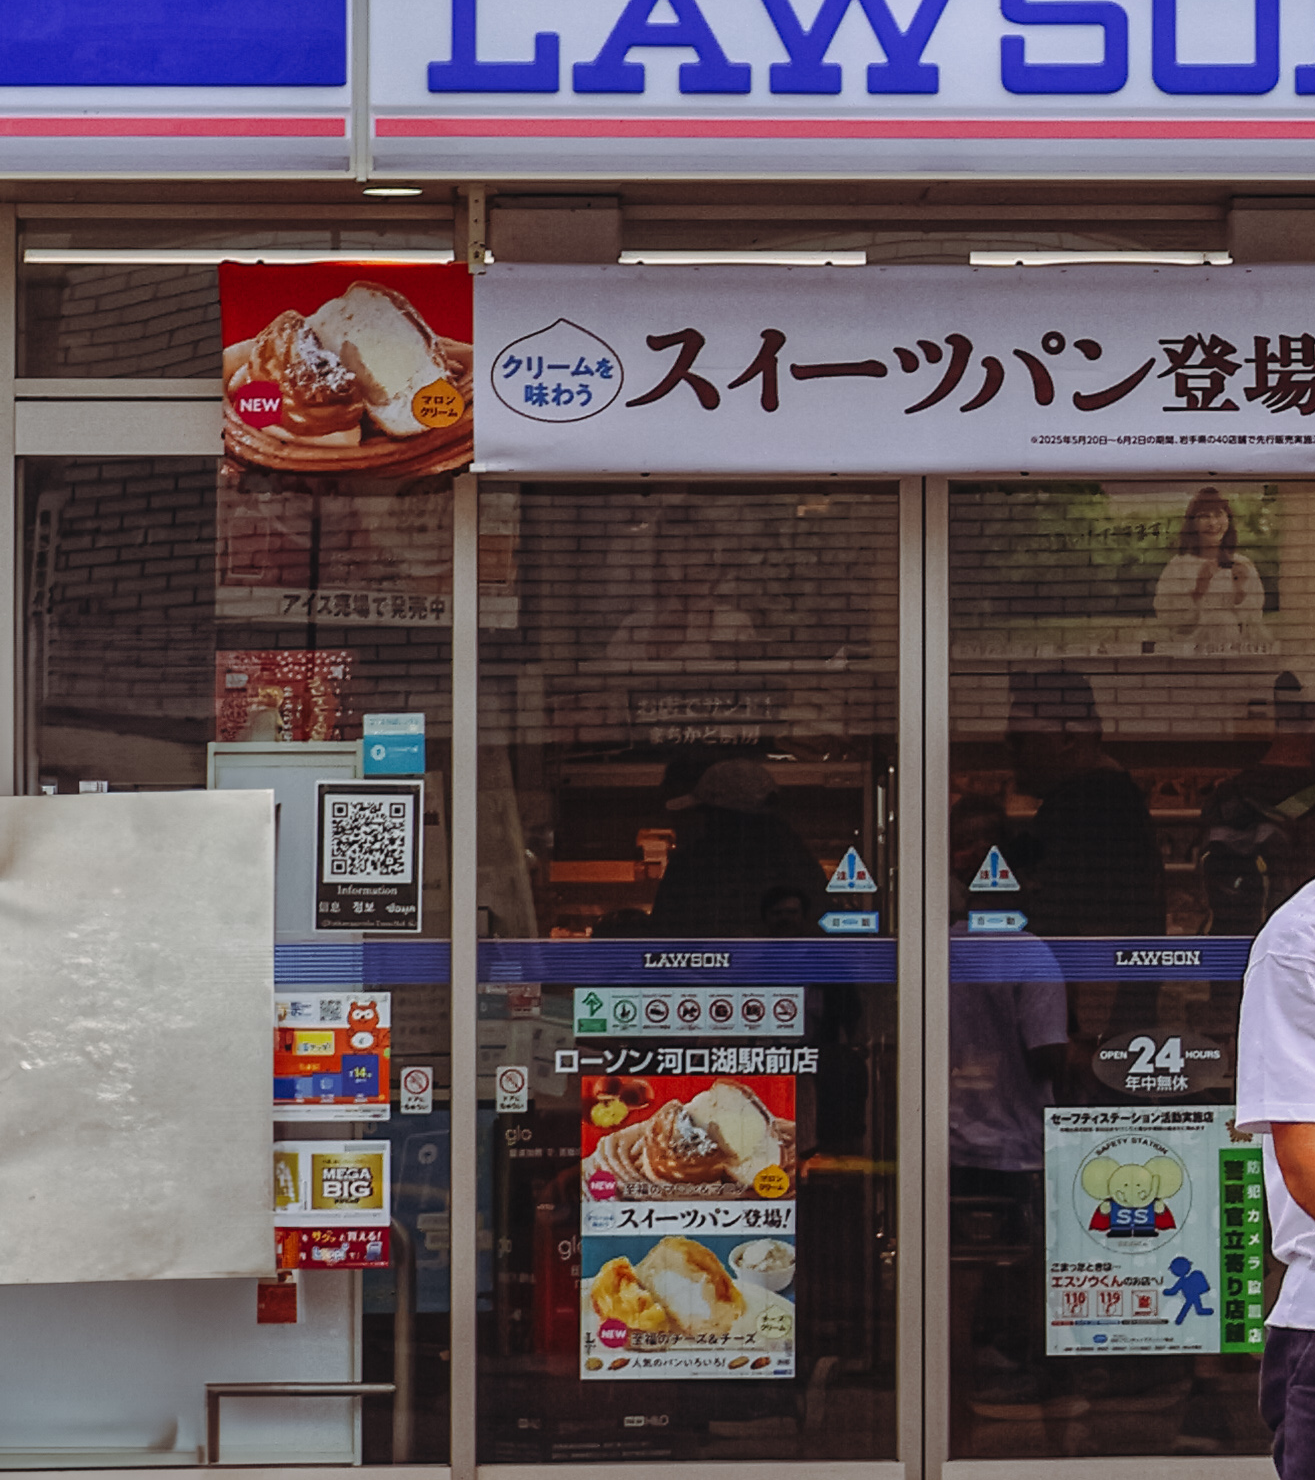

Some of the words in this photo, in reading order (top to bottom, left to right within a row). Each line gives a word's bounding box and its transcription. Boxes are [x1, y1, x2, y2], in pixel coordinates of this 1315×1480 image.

[501, 355, 615, 380] クリームを
[421, 395, 453, 406] マロン
[523, 382, 594, 408] 味わう
[239, 397, 280, 414] NEW
[420, 407, 459, 418] クリーム
[337, 884, 398, 896] Information
[643, 952, 730, 968] LAWSON
[1115, 950, 1201, 966] LAWSON
[554, 1046, 819, 1075] ローソン河口湖駅前店
[1099, 1050, 1128, 1060] OPEN
[1128, 1036, 1185, 1073] 24
[1185, 1050, 1221, 1060] HOURS
[1125, 1075, 1189, 1091] 年中無休
[505, 1124, 533, 1146] glo
[1096, 1136, 1129, 1156] SAFETY
[1131, 1136, 1169, 1155] STATION
[322, 1167, 372, 1180] MEGA
[322, 1180, 373, 1198] BIG
[590, 1181, 616, 1191] NEW
[616, 1207, 793, 1230] スイーツパン登場!
[1116, 1208, 1150, 1224] SS
[1064, 1292, 1087, 1305] 110
[1099, 1292, 1121, 1304] 119
[601, 1329, 627, 1339] NEW
